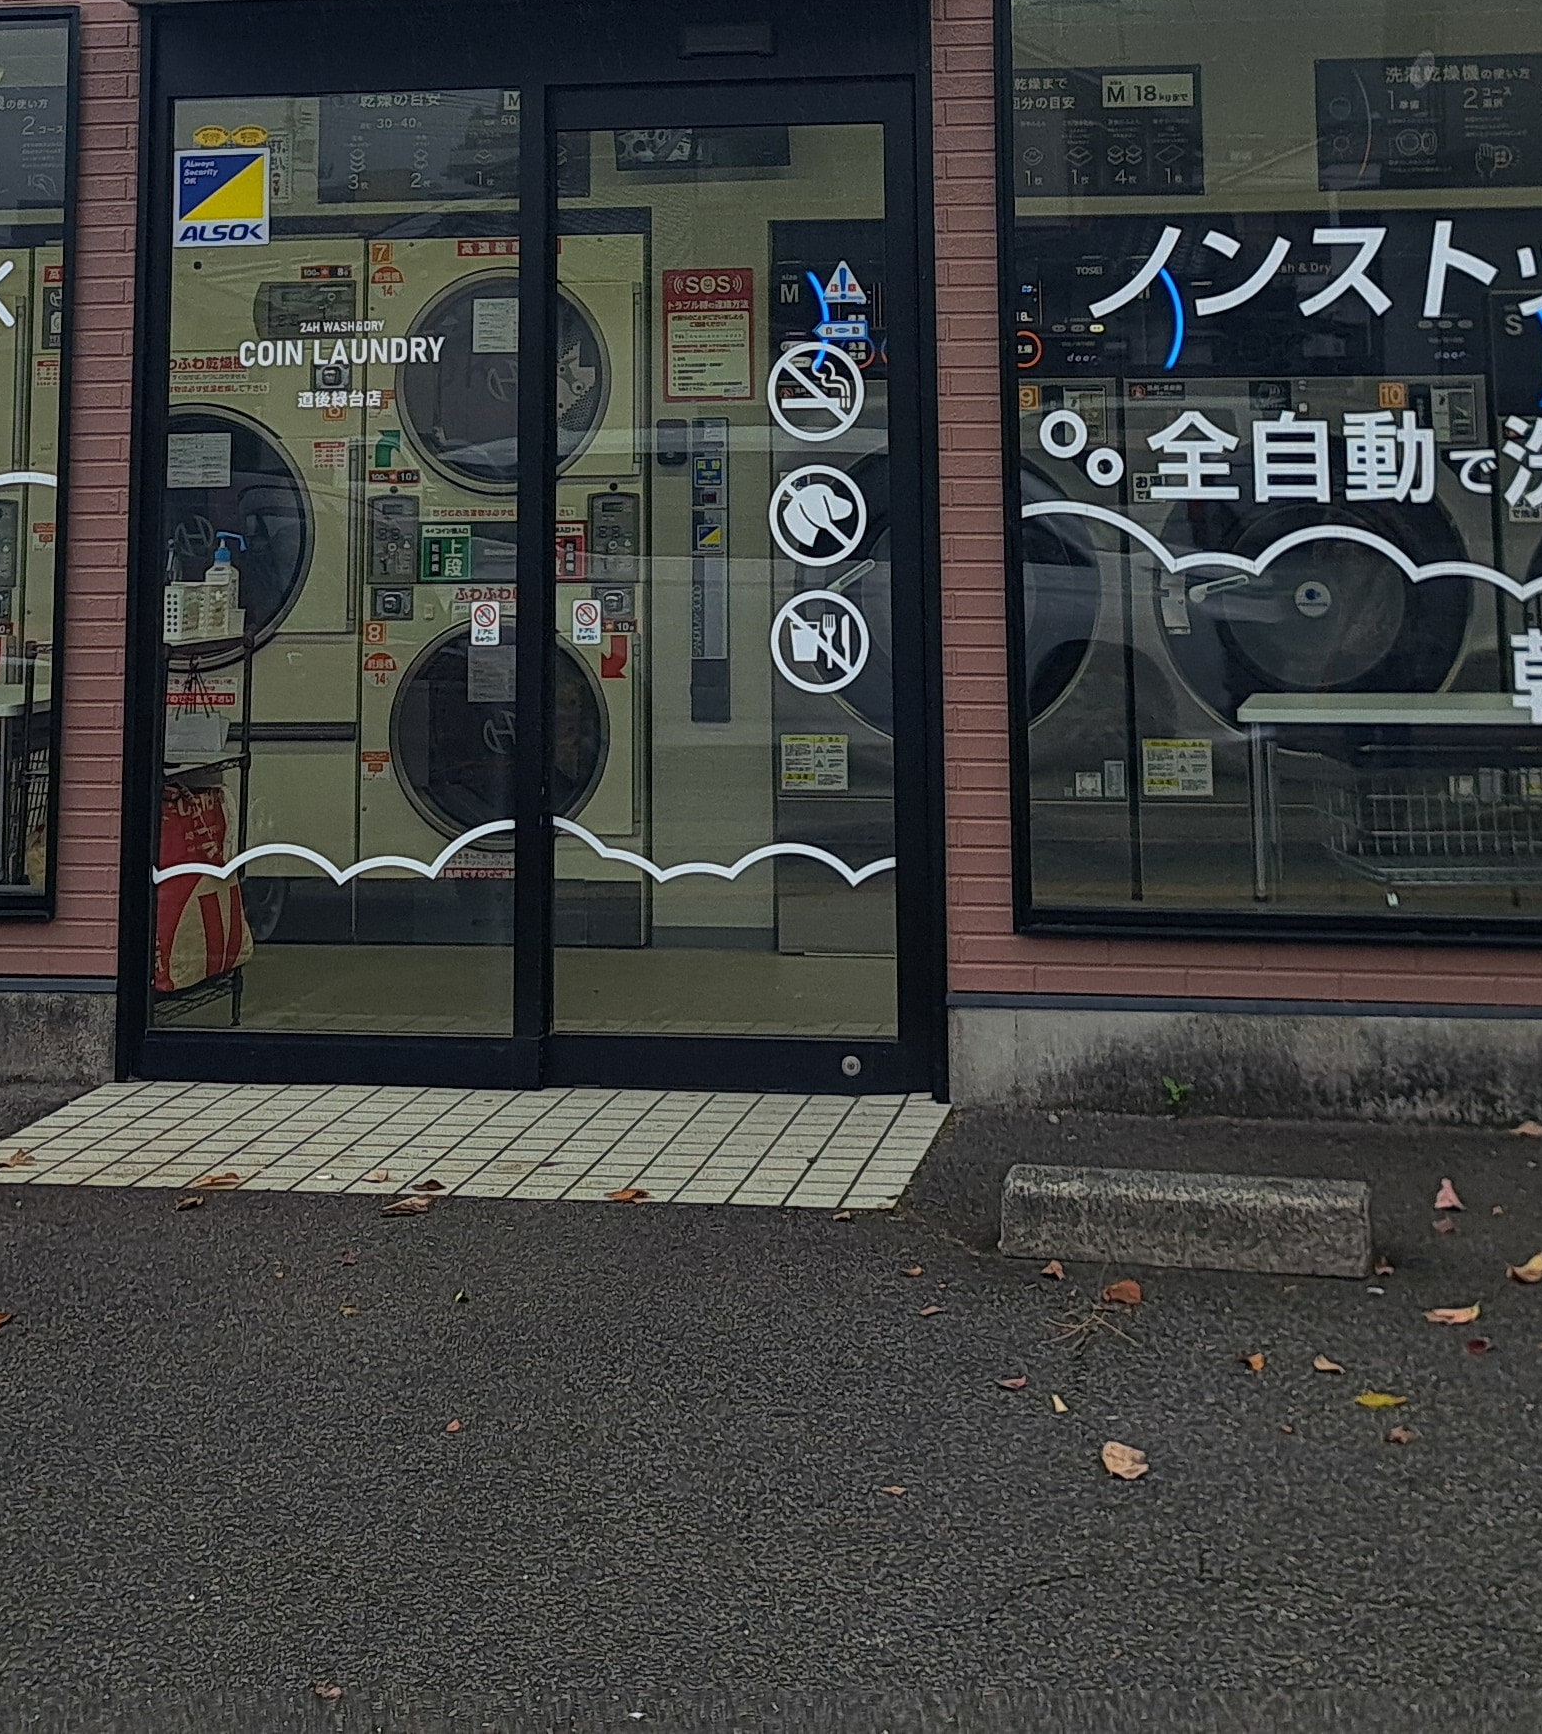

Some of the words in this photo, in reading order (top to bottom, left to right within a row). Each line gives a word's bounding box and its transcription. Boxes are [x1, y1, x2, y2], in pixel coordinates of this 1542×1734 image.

[360, 93, 441, 109] 乾燥の目安
[1107, 85, 1125, 103] M
[183, 168, 219, 177] Security
[178, 223, 264, 243] ALSOK
[375, 244, 388, 262] 7
[685, 275, 731, 294] SOS
[780, 283, 799, 303] M
[1504, 313, 1524, 337] S
[238, 340, 304, 367] COIN
[312, 335, 447, 366] LAUNDRY
[296, 390, 382, 409] 道後緑台店
[1020, 386, 1035, 408] 9
[367, 623, 382, 642] 8
